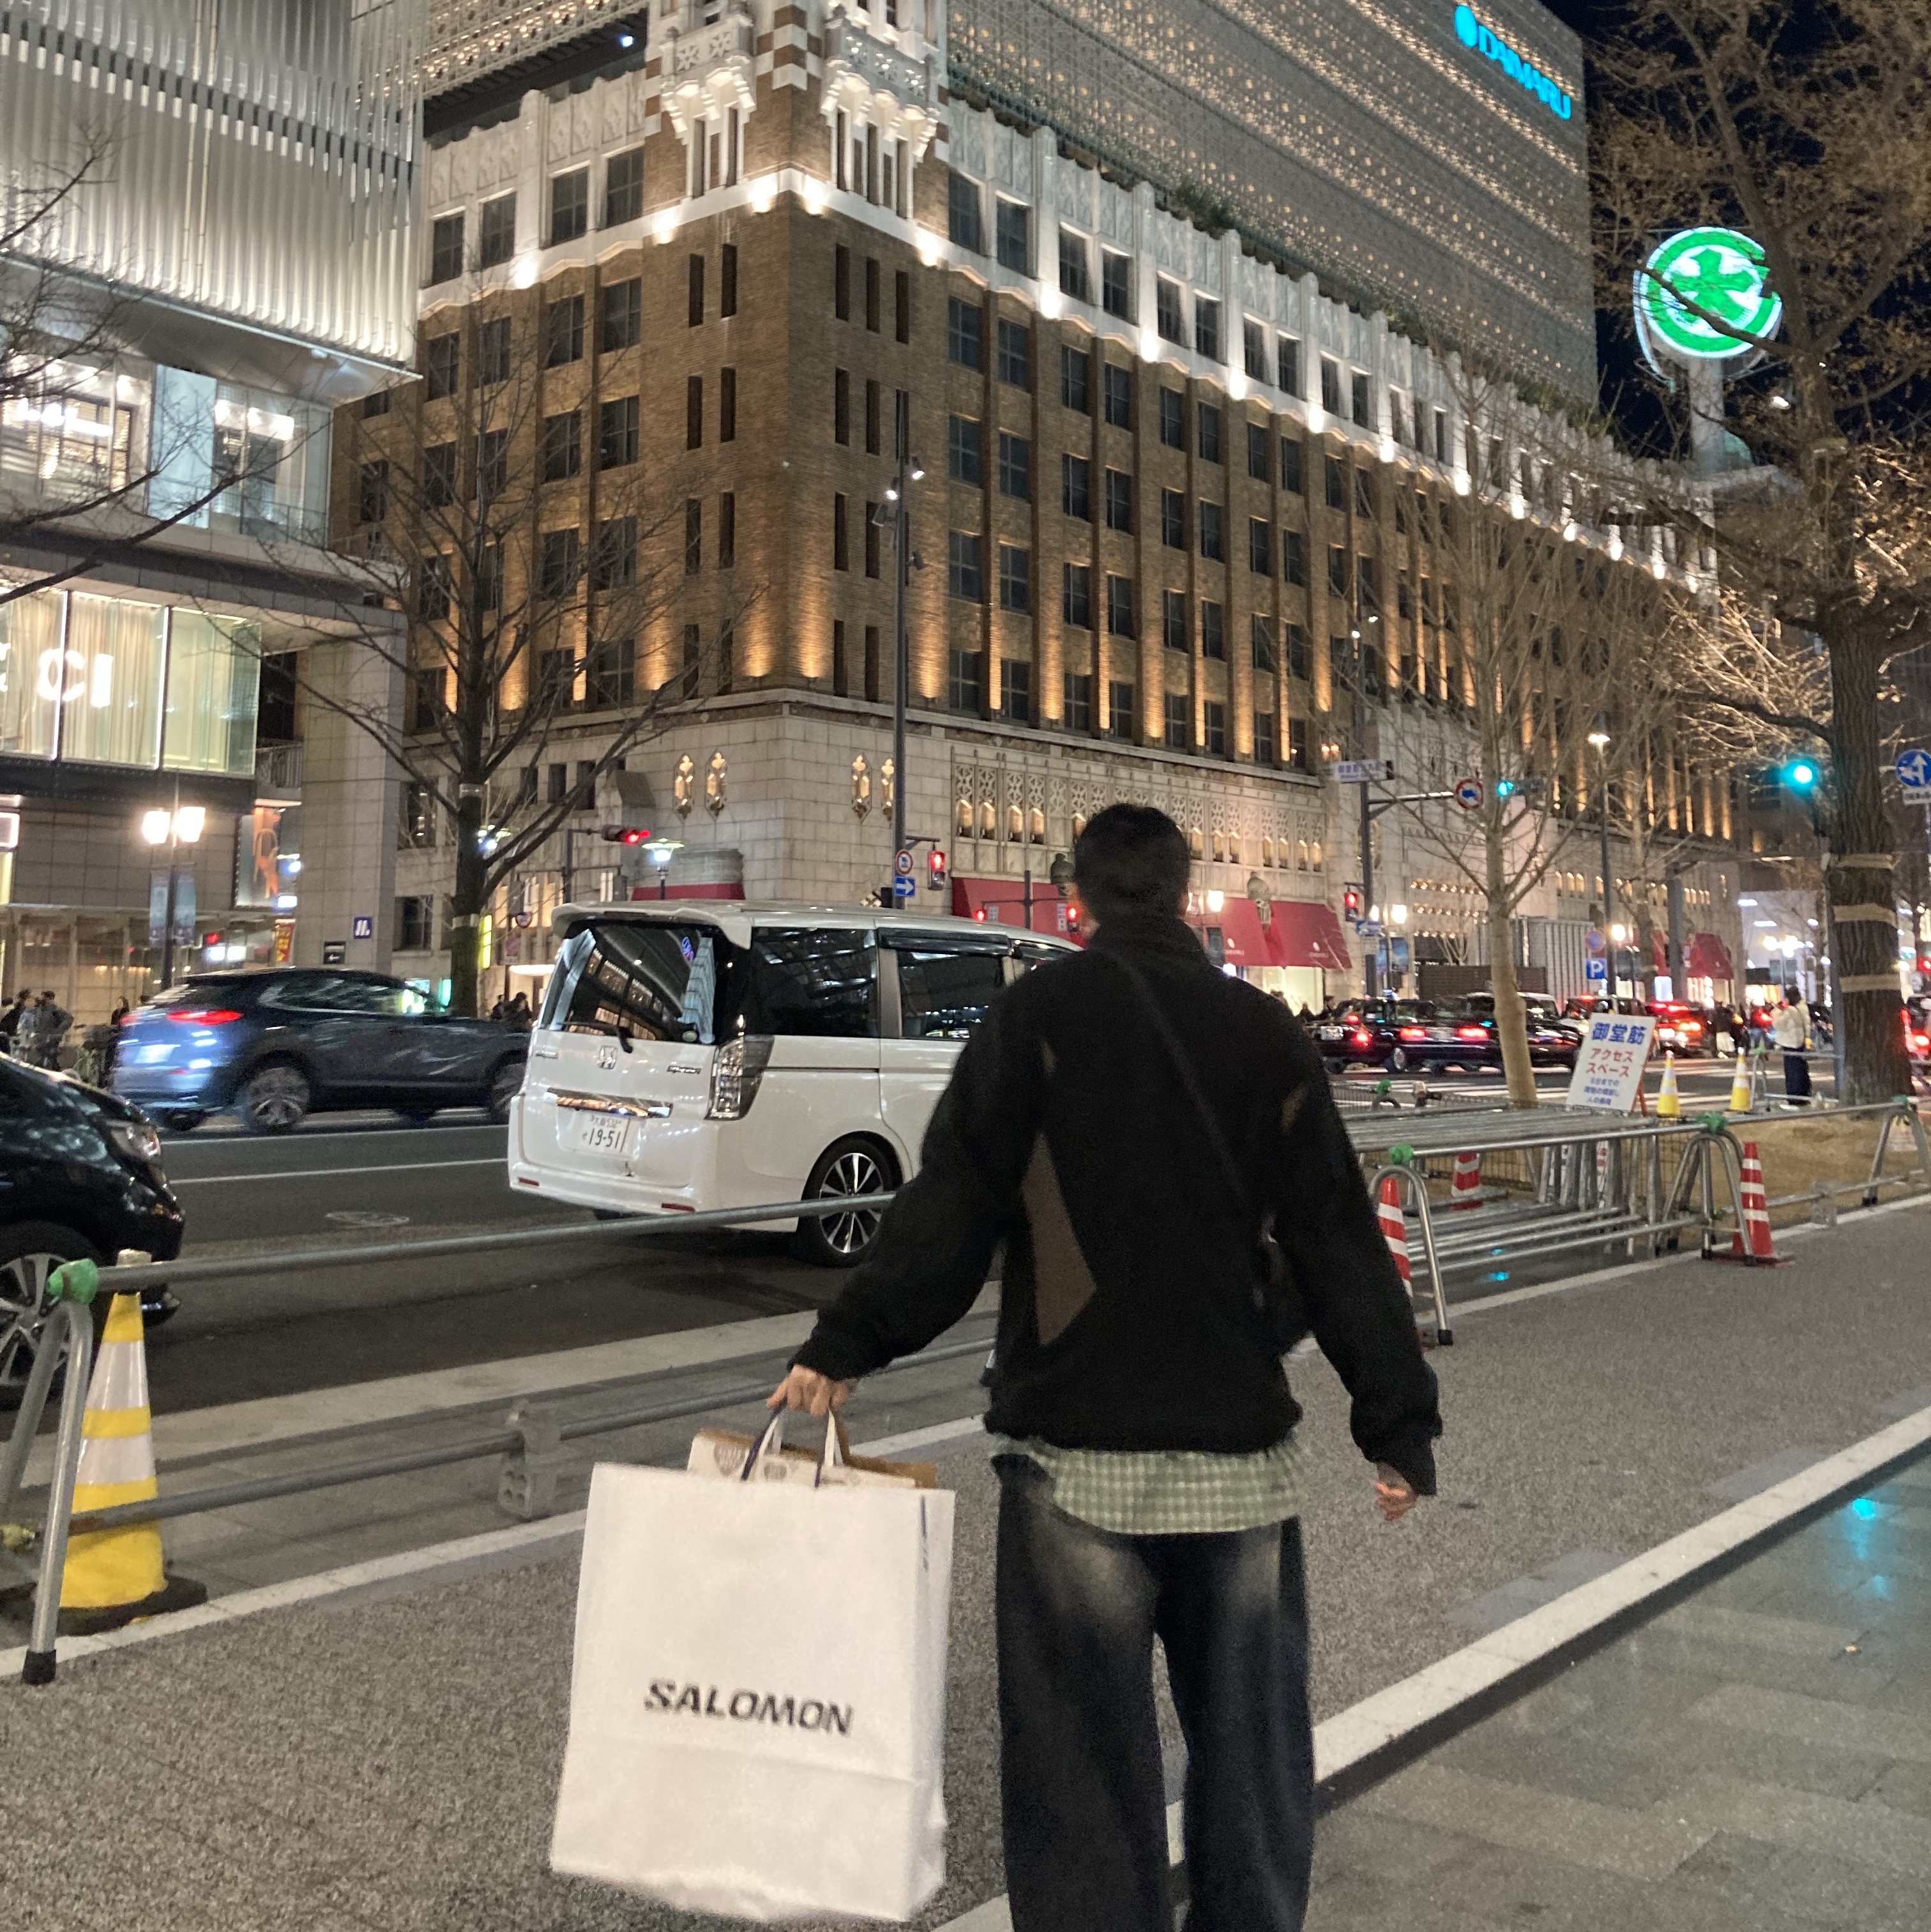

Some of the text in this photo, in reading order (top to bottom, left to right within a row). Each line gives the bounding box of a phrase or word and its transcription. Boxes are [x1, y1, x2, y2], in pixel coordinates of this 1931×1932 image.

[1590, 960, 1604, 978] P
[1591, 1022, 1647, 1044] 御堂筋
[1589, 1048, 1633, 1062] アクセス
[1586, 1062, 1630, 1077] スペース
[589, 1128, 621, 1148] 19-51
[644, 1678, 854, 1737] SALOMON
